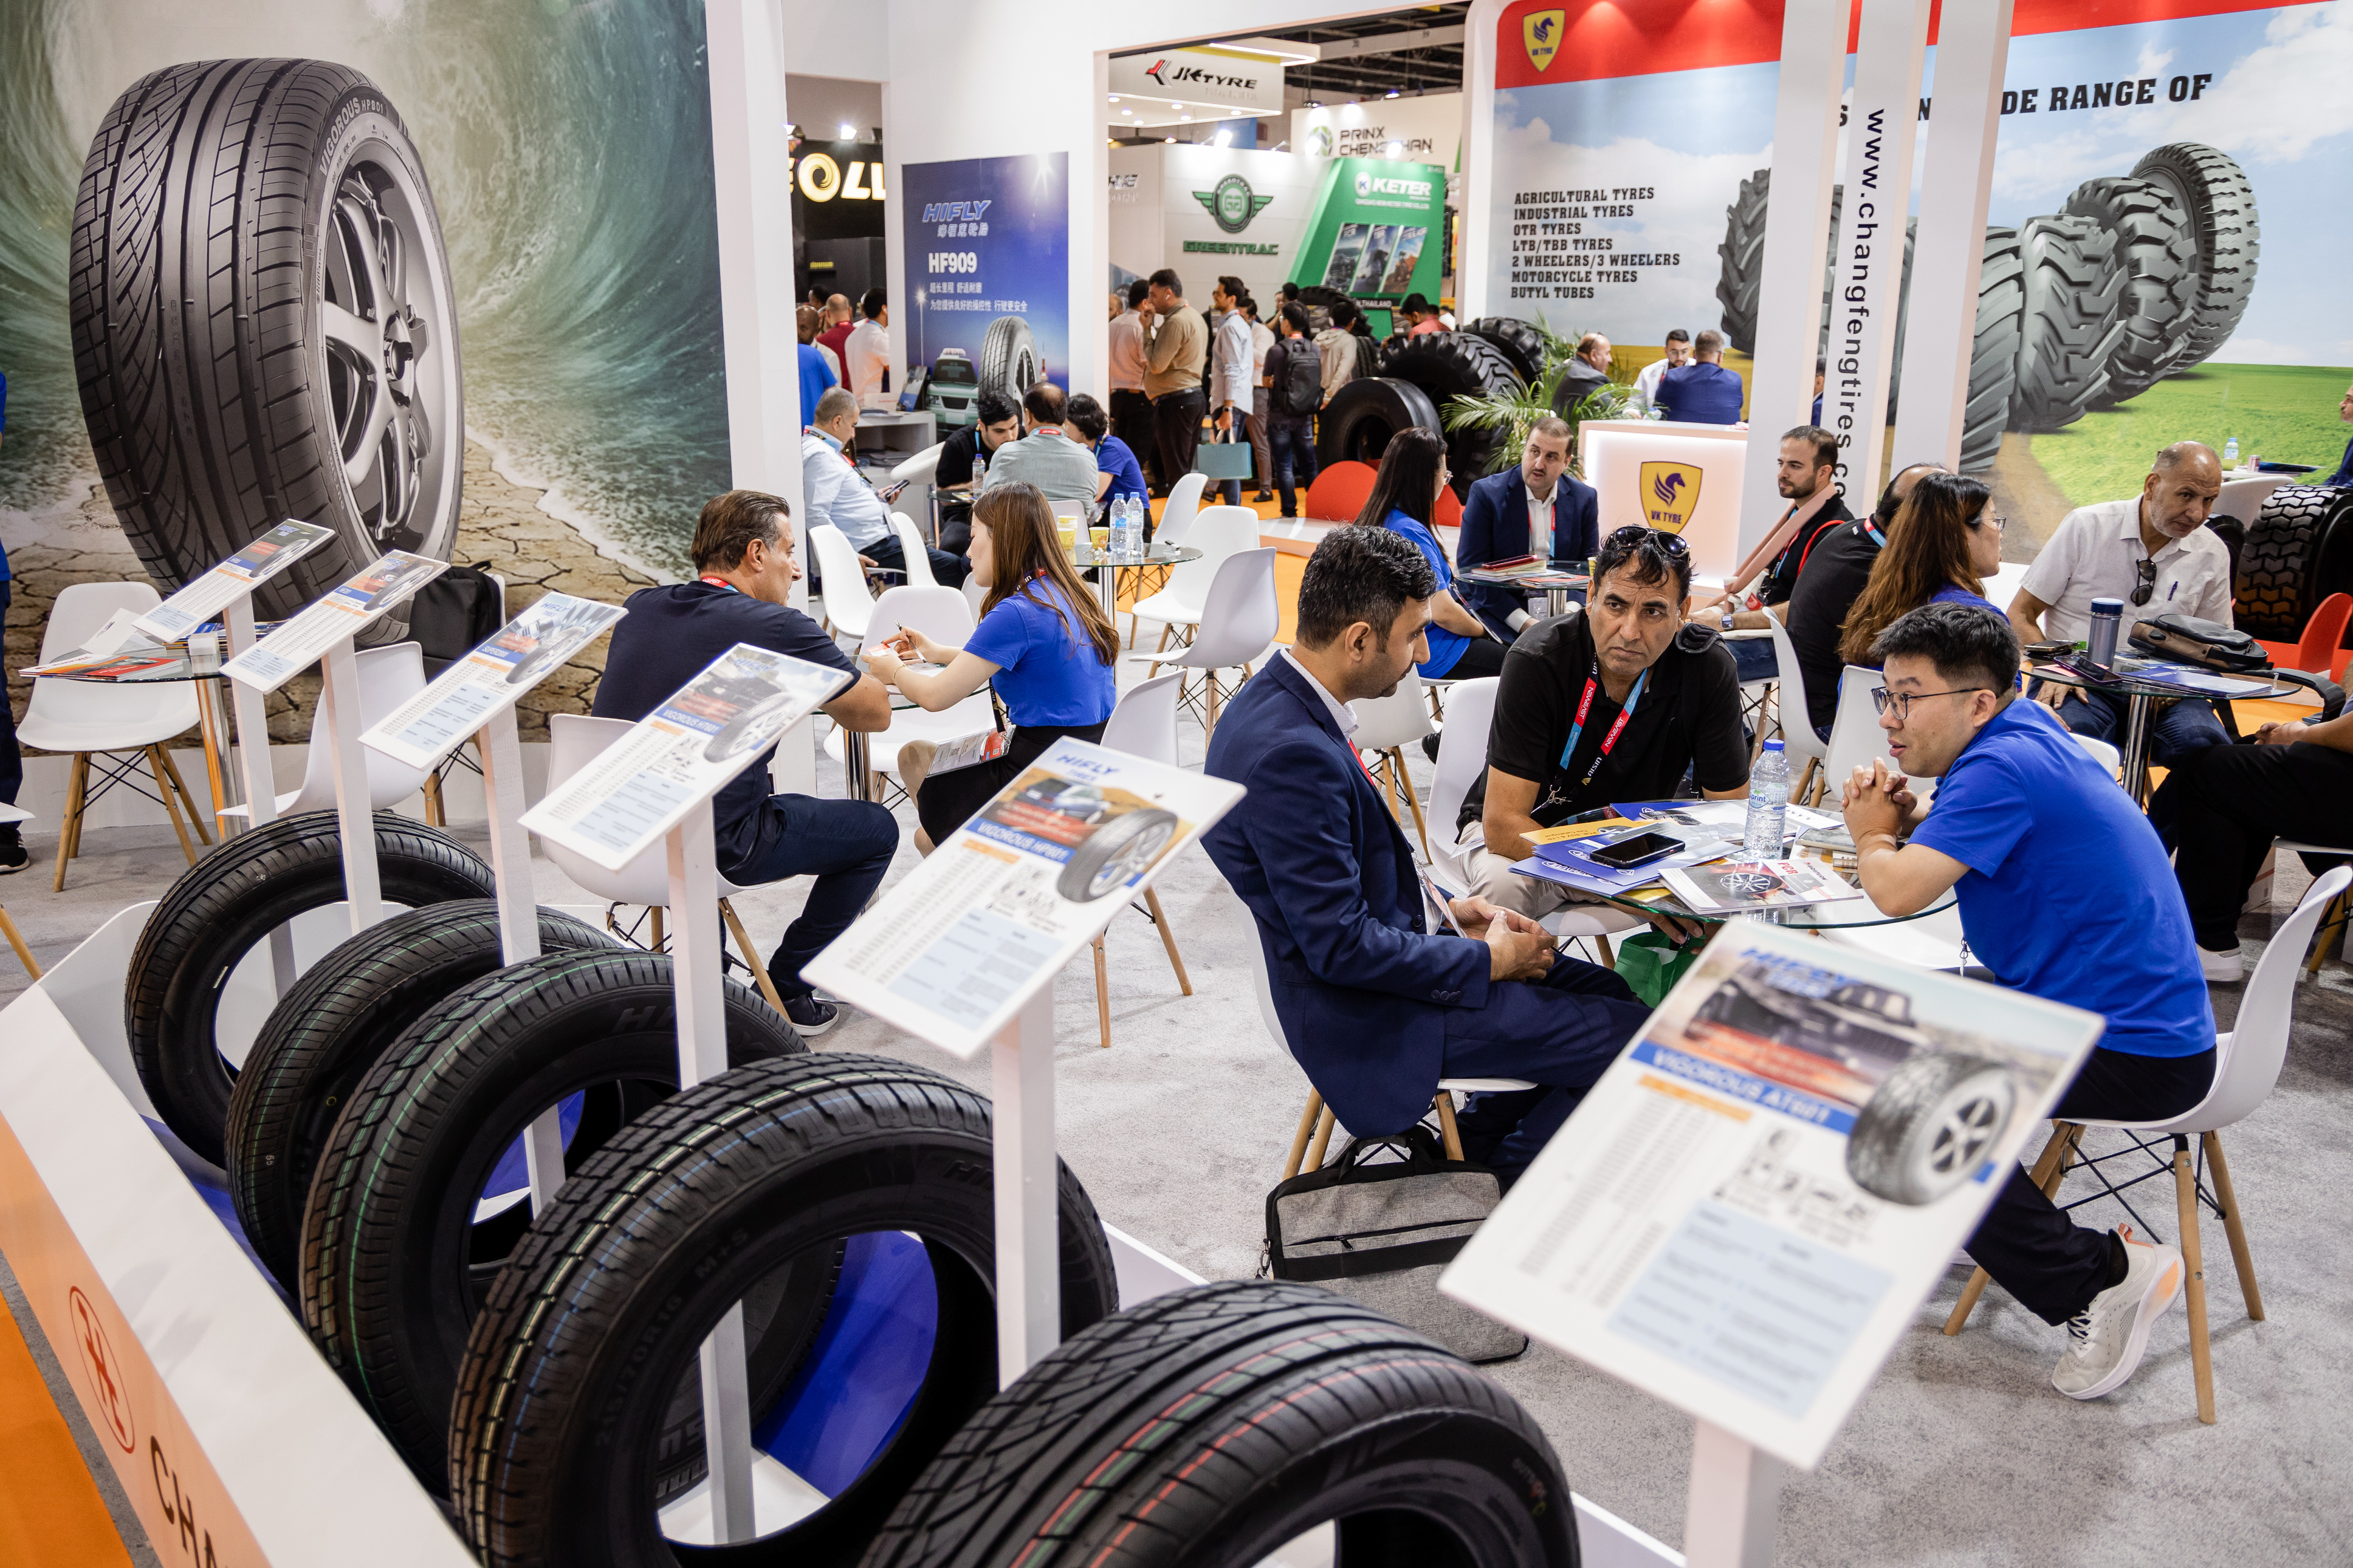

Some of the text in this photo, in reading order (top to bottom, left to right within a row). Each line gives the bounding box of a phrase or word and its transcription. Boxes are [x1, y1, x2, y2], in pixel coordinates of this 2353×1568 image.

[2001, 89, 2039, 115] DE
[2049, 78, 2157, 112] RANGE
[2168, 73, 2213, 101] OF
[319, 97, 361, 176] VIGOROUS
[1341, 126, 1386, 142] PRINX
[1339, 138, 1433, 156] CHENGHAN
[1371, 178, 1432, 197] KETER
[1514, 187, 1655, 204] AGRICULTURAL TYRES
[922, 199, 992, 223] HIFLY
[1514, 205, 1634, 220] INDUSTRIAL TYRES
[1513, 223, 1581, 236] OTR TYRES
[1513, 238, 1613, 254] LTB/TBB TYRES
[928, 252, 978, 273] HF909
[1512, 253, 1681, 269] 2 WHEELERS/3 WHEELERS
[1511, 270, 1638, 284] MOTORCYCLE TYRES
[1511, 286, 1595, 299] BUTYL TUBES
[1651, 510, 1682, 524] VK TYRE
[540, 602, 570, 612] HIFLY
[662, 708, 699, 727] VIGOROUS
[1604, 716, 1624, 748] NEWEAST
[1587, 756, 1602, 777] AISIN
[1778, 862, 1798, 874] PCR
